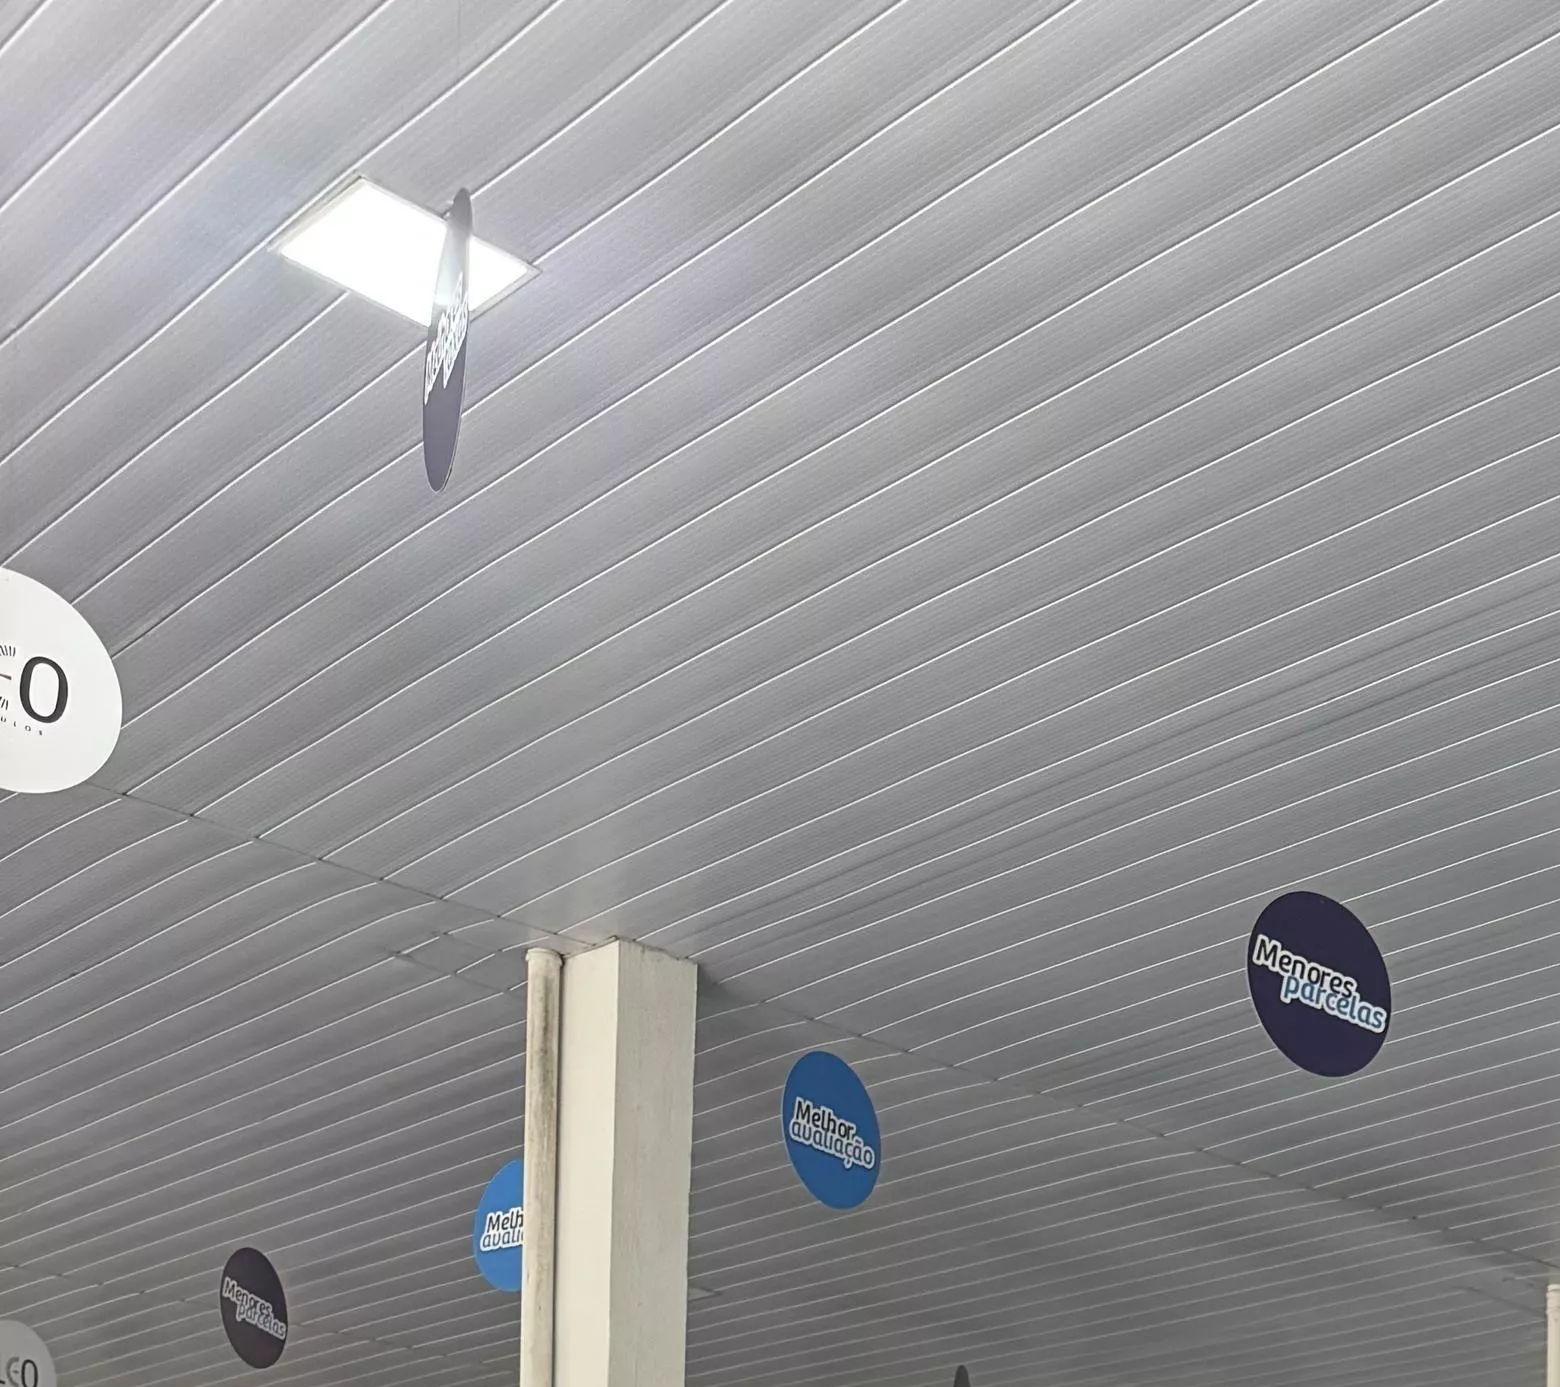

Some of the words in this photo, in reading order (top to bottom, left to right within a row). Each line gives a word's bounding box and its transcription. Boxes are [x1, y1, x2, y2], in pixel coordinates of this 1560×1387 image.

[1255, 938, 1354, 998] Menores
[1283, 976, 1384, 1029] parcelas
[795, 1100, 855, 1141] Melhor
[791, 1121, 874, 1166] avaliação
[223, 1277, 272, 1316] Menores
[236, 1302, 286, 1338] parcelas
